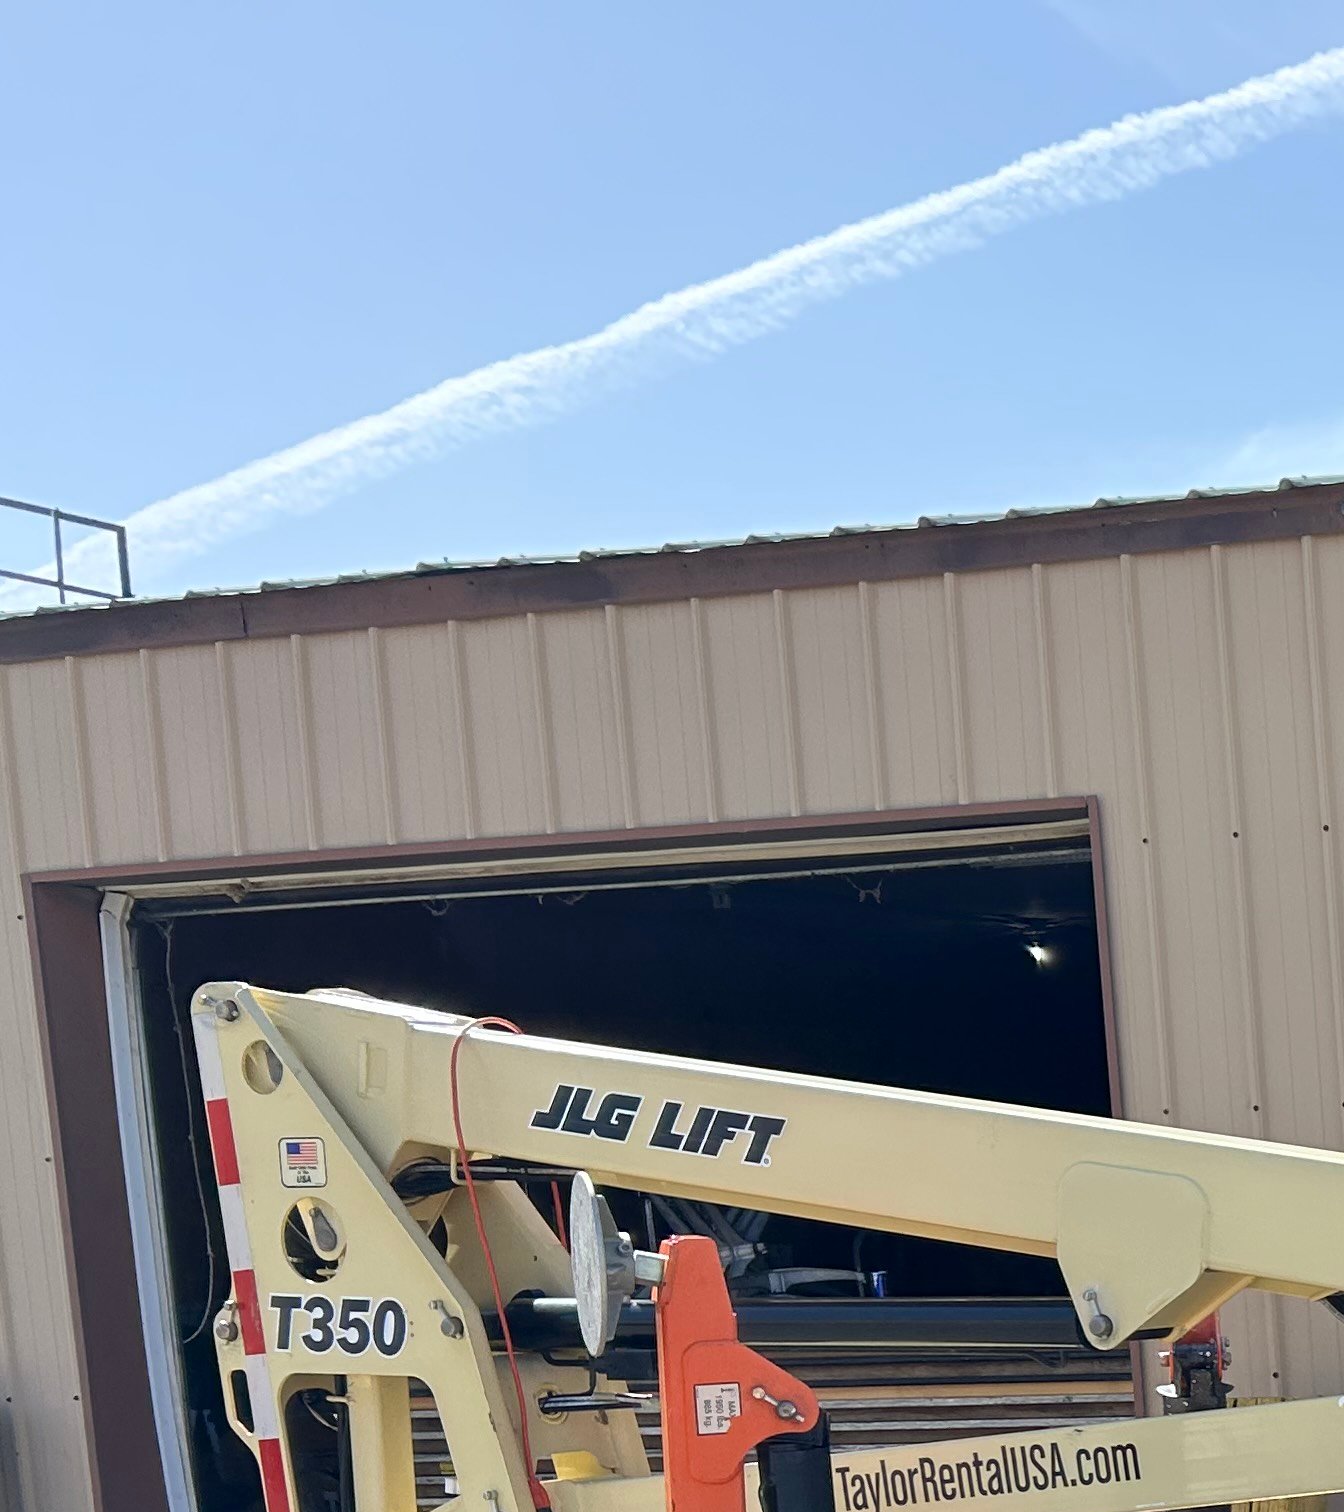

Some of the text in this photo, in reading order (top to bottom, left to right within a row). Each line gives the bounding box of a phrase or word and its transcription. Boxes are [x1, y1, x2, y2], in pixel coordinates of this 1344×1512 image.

[529, 1083, 787, 1166] JLG LIFT
[296, 1175, 311, 1183] USA
[269, 1294, 407, 1358] T350
